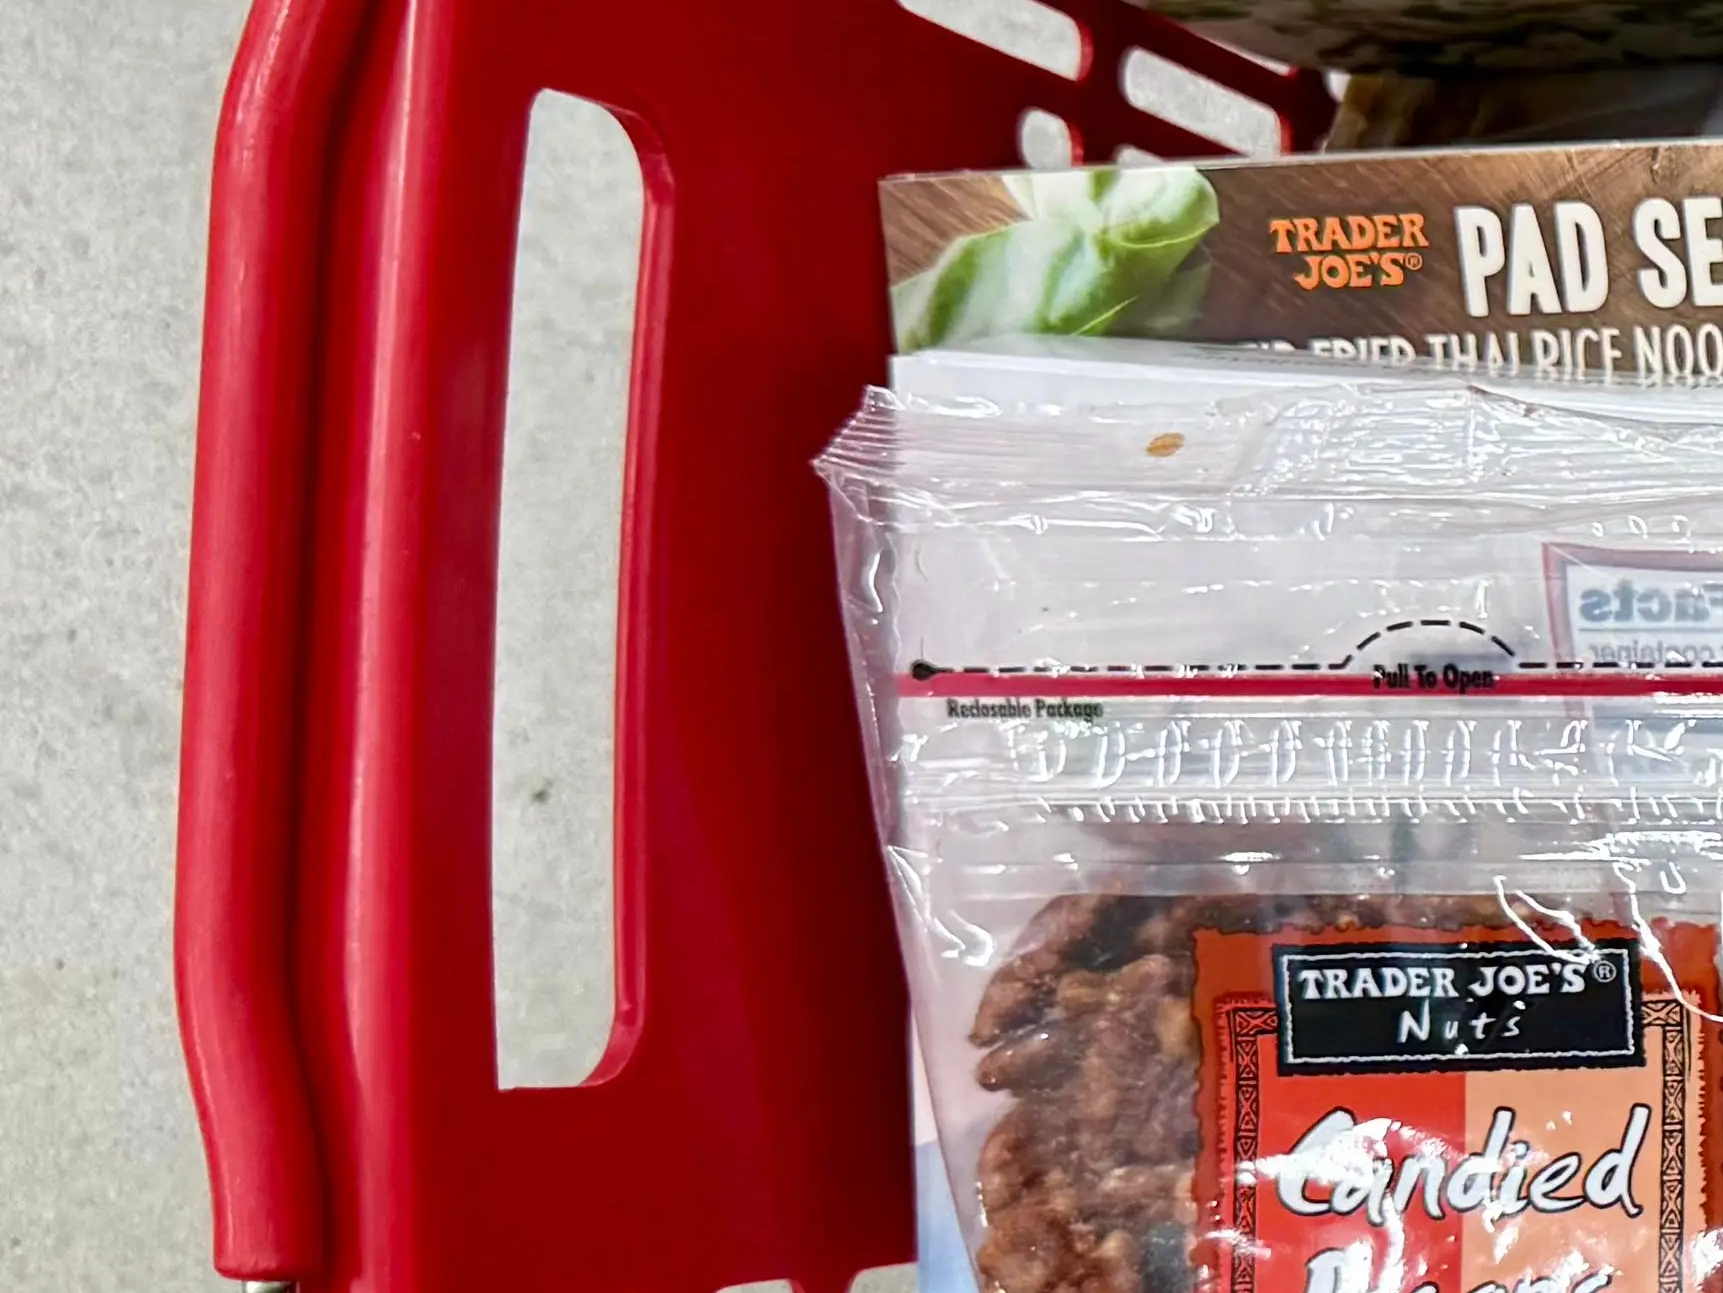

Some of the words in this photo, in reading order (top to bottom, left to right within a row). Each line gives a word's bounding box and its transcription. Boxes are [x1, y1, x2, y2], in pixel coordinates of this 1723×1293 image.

[1269, 213, 1429, 253] TRADER
[1293, 251, 1405, 290] JOE'S
[1451, 200, 1610, 318] PAD
[1535, 326, 1623, 381] RICE
[1373, 662, 1411, 689] Pull
[1415, 664, 1439, 689] To
[1443, 663, 1498, 695] Open
[946, 698, 1032, 718] Reclosable
[1035, 699, 1104, 720] Package
[1298, 966, 1460, 1001] TRADER
[1466, 962, 1588, 998] JOE'S
[1398, 998, 1524, 1043] Nuts
[1275, 1103, 1653, 1226] Candied
